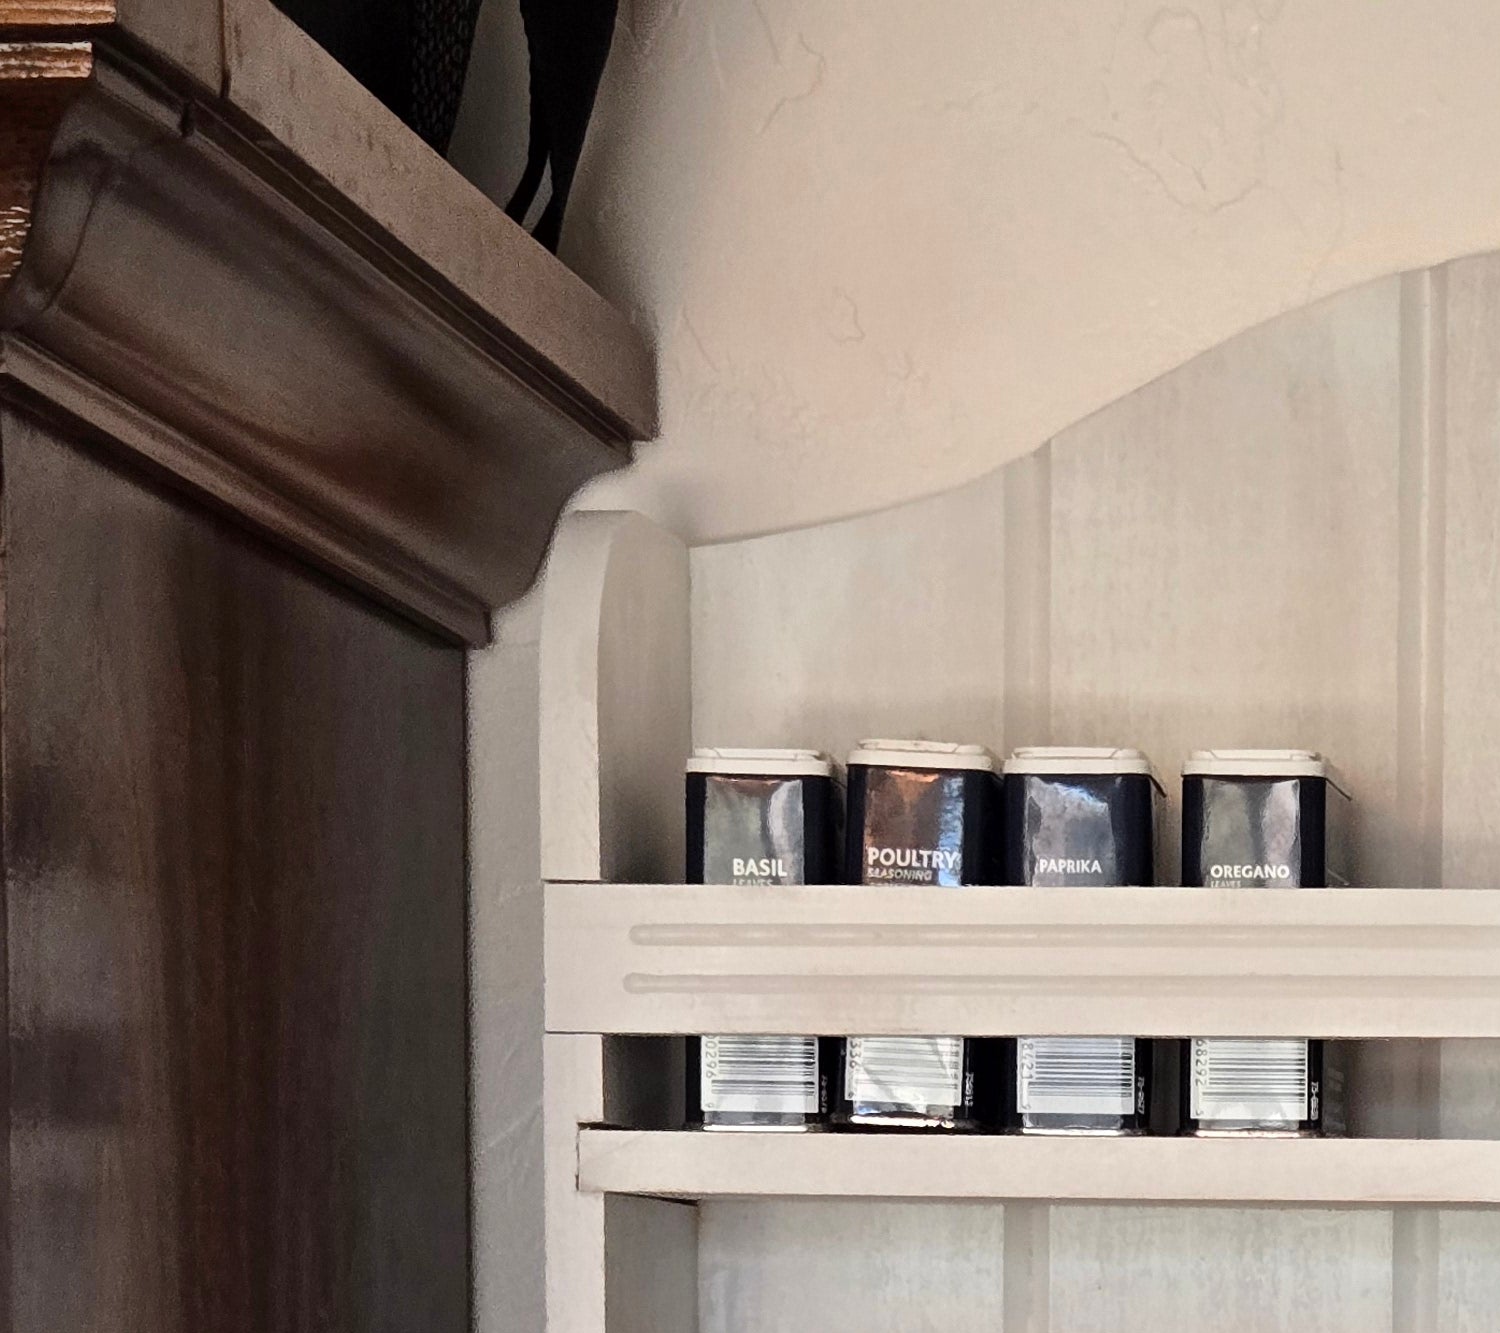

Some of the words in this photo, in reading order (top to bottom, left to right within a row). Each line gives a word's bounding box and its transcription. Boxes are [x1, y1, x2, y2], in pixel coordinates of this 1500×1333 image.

[867, 846, 962, 870] POULTRY
[1039, 858, 1103, 875] PAPRIKA
[732, 858, 788, 877] BASIL
[1210, 863, 1291, 879] OREGANO
